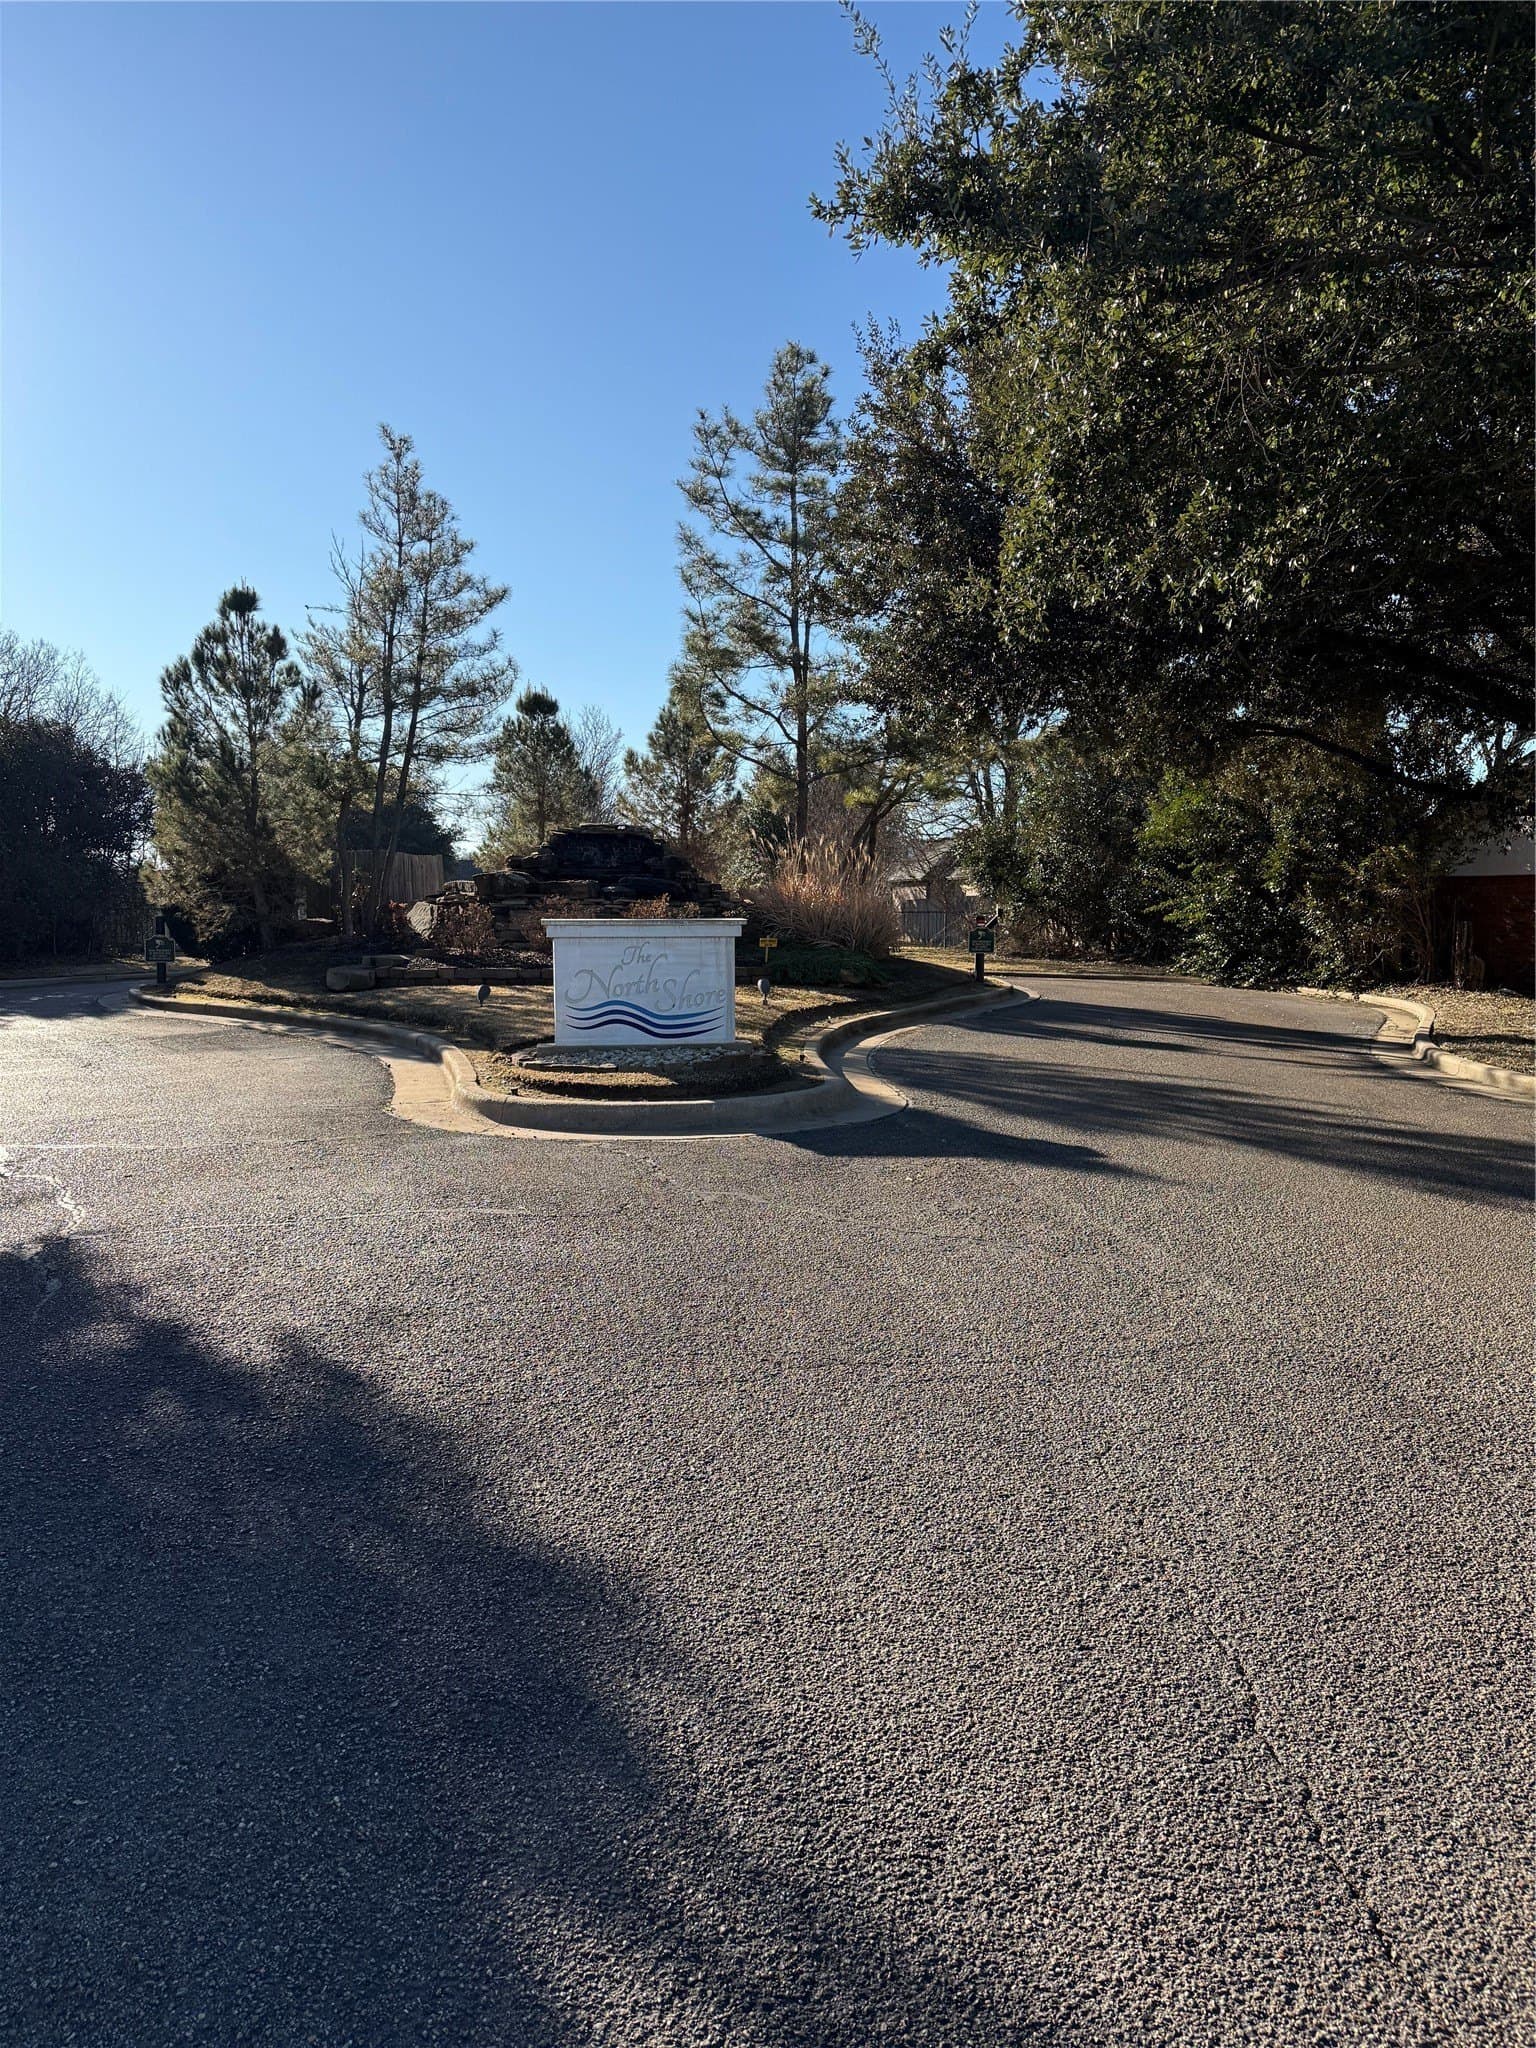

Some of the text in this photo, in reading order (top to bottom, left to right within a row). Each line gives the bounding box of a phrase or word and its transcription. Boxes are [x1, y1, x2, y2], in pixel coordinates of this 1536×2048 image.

[621, 941, 652, 966] The
[565, 953, 727, 1012] North Shore
